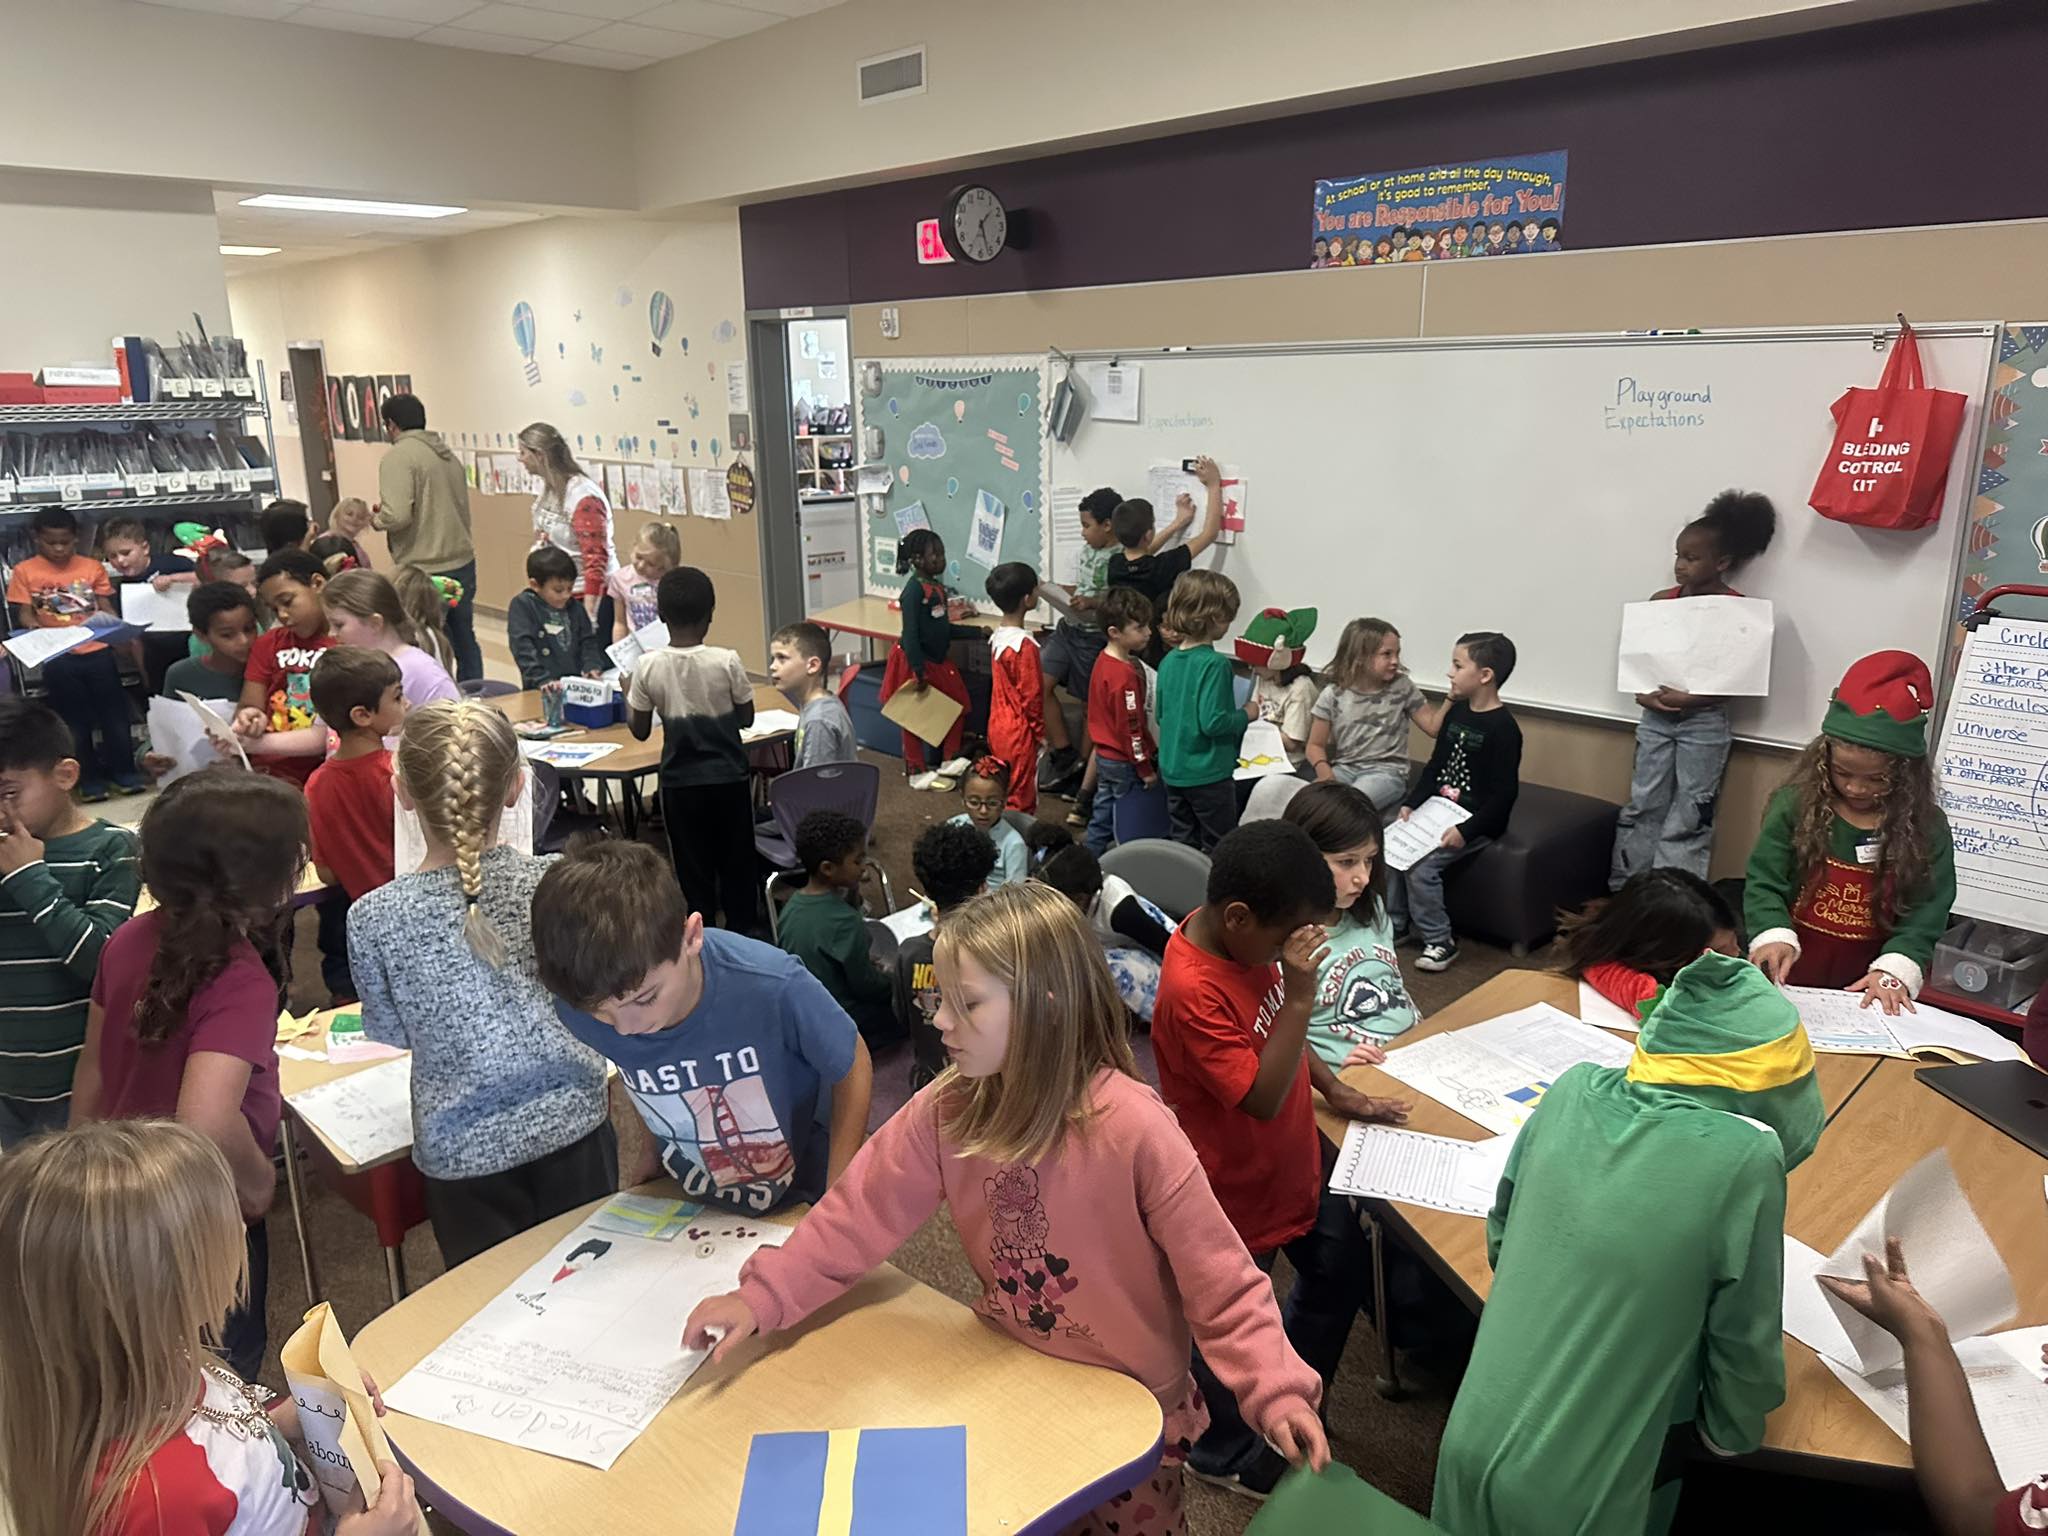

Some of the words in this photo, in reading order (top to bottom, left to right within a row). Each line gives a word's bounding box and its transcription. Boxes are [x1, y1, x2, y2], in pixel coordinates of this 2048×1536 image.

[1325, 194, 1336, 206] At
[1338, 182, 1368, 201] school
[1370, 181, 1381, 190] or
[1384, 177, 1395, 188] at
[1398, 172, 1426, 185] home
[1450, 168, 1461, 179] all
[1464, 167, 1481, 178] the
[1484, 167, 1503, 182] day
[1507, 168, 1552, 187] through,
[976, 190, 985, 200] 12
[1395, 187, 1421, 202] good
[1424, 186, 1435, 197] to
[1315, 209, 1345, 231] You
[1348, 209, 1373, 228] are
[1375, 193, 1480, 228] Responsible
[1481, 193, 1513, 216] for
[1516, 183, 1562, 213] You!
[205, 382, 216, 394] E
[237, 381, 246, 393] E
[1617, 377, 1712, 410] Playground
[331, 382, 410, 435] COA
[1604, 406, 1705, 435] Expectations
[138, 480, 150, 492] G
[170, 478, 181, 490] G
[201, 477, 210, 488] G
[234, 478, 245, 489] H
[65, 484, 78, 498] G
[567, 683, 592, 696] ASKING
[1814, 901, 1873, 927] Christma
[1966, 975, 1973, 987] 3
[715, 1046, 760, 1081] TO
[492, 1401, 618, 1456] Sweden
